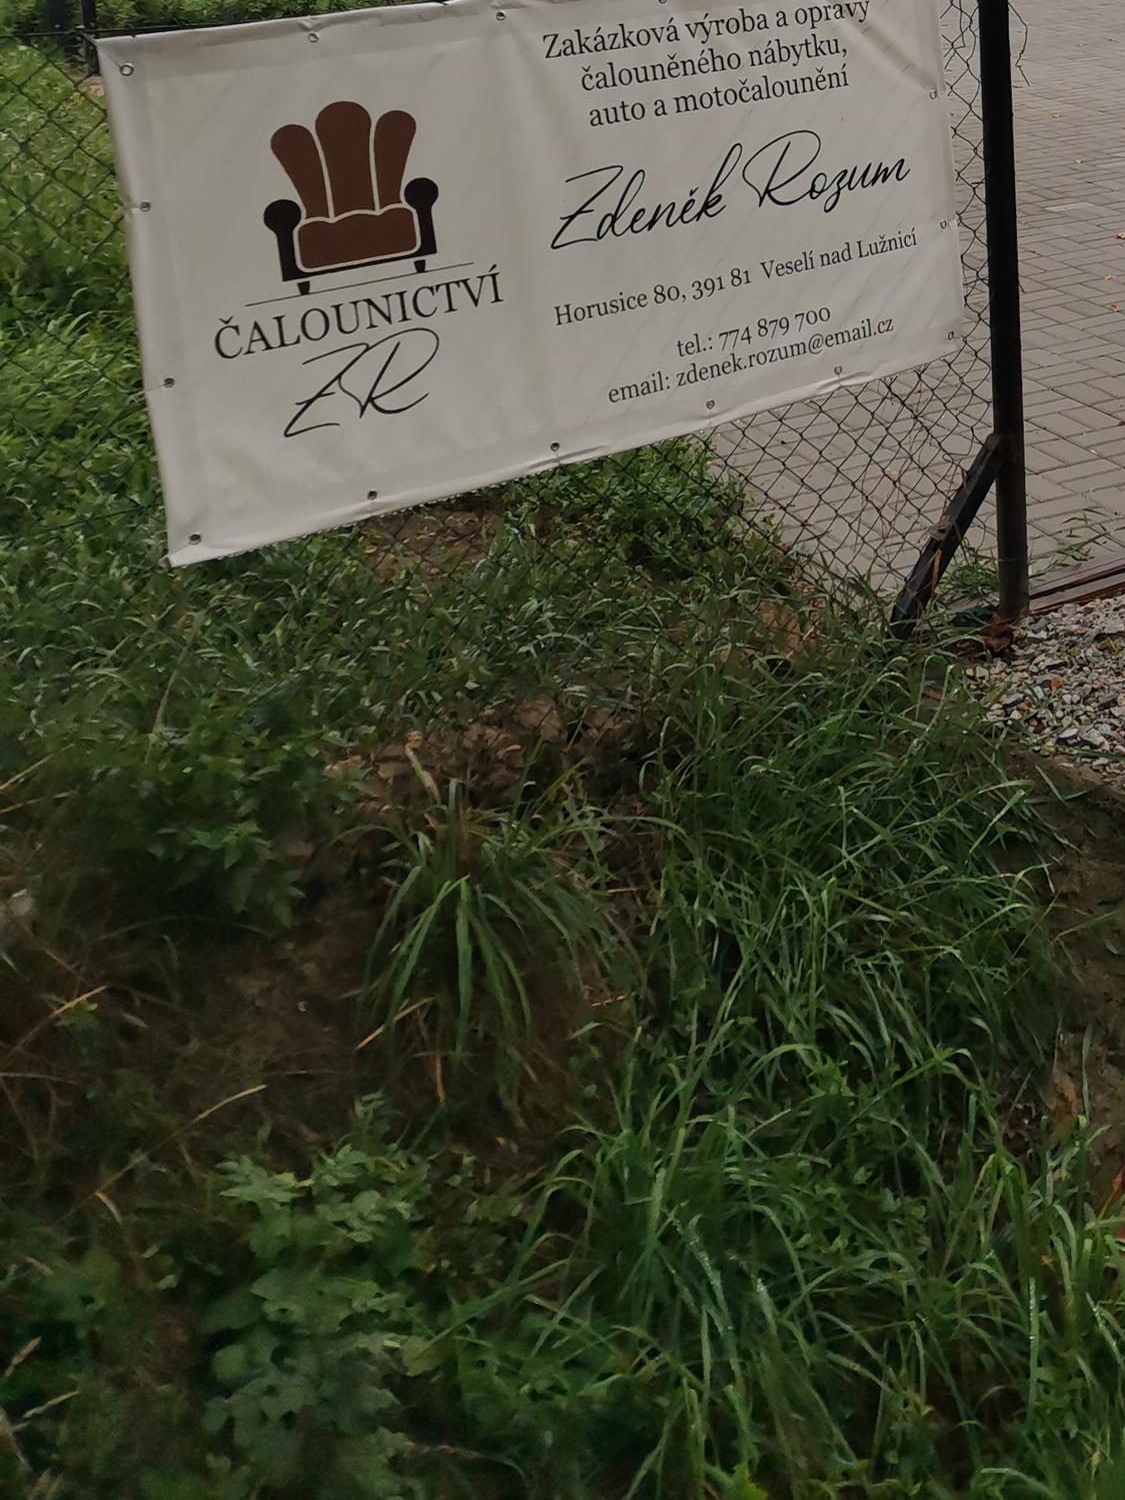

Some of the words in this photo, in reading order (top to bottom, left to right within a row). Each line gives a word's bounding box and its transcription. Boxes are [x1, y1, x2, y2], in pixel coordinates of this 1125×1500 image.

[543, 16, 681, 59] Zakázková
[685, 7, 769, 44] výroba
[775, 9, 789, 28] a
[794, 0, 870, 29] opravy
[581, 47, 742, 92] čalouněného
[747, 33, 848, 60] nábytku,
[589, 99, 647, 127] auto
[653, 97, 668, 117] a
[674, 62, 850, 115] motočalounění
[550, 142, 743, 250] Zdeněk
[742, 129, 911, 213] Rozum
[213, 264, 504, 360] ČALOUNICTVÍ
[554, 291, 649, 326] Horusice
[653, 284, 687, 304] 80,
[691, 276, 726, 301] 391
[729, 267, 752, 289] 81
[760, 252, 816, 280] Veselí
[819, 242, 854, 268] nad
[856, 228, 918, 260] Lužnicí
[608, 373, 671, 403] email:
[676, 316, 895, 388] zdenek.rozum@email.cz
[676, 334, 714, 358] tel.:
[718, 325, 753, 353] 774
[757, 314, 790, 340] 879
[794, 306, 832, 332] 700
